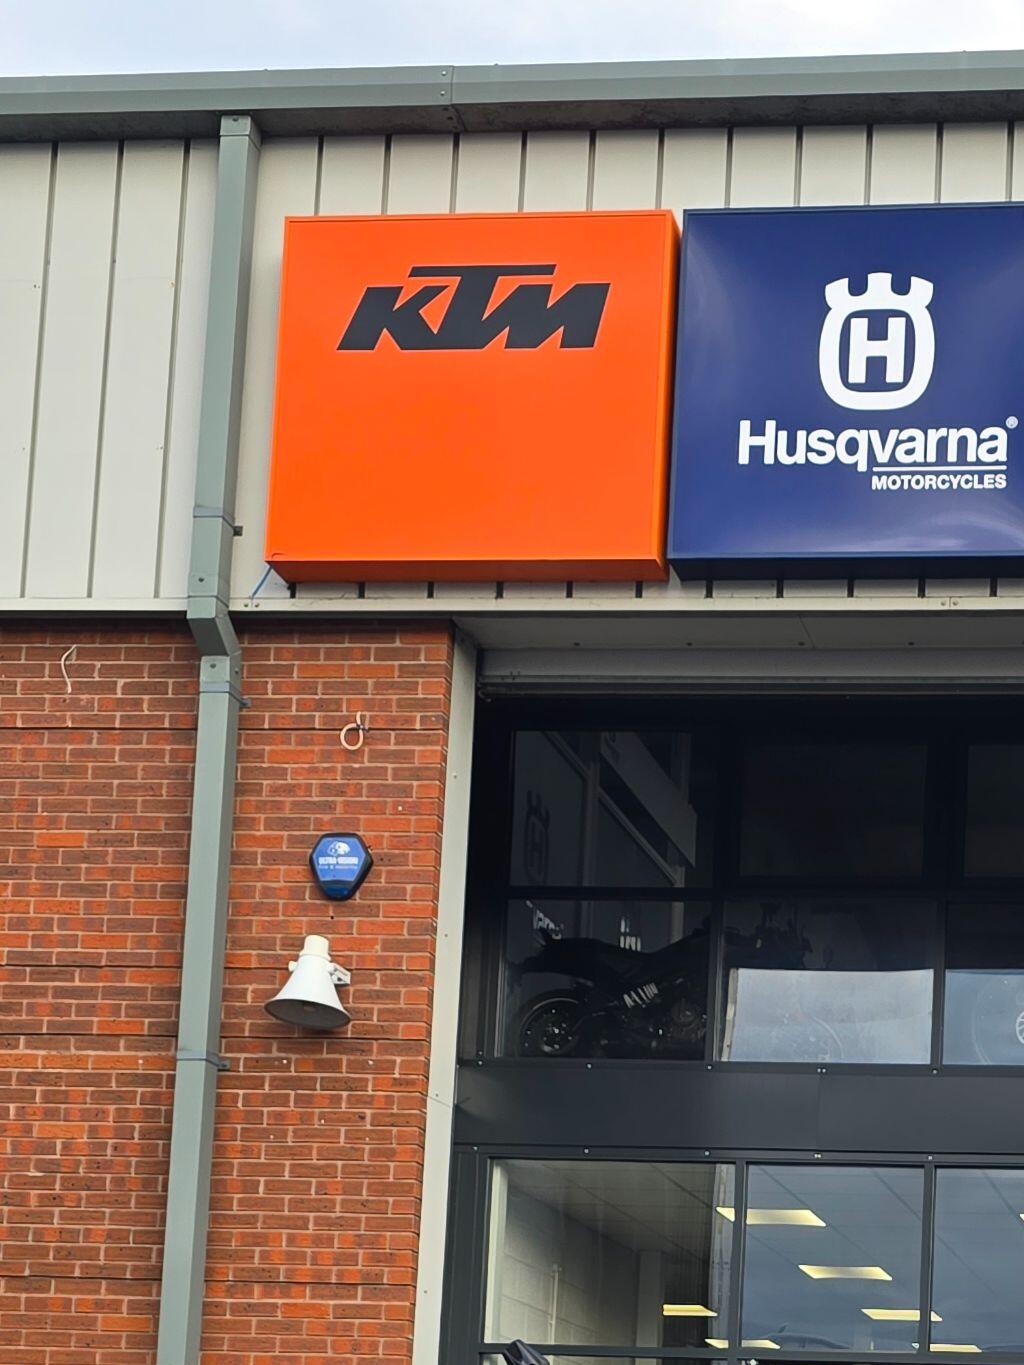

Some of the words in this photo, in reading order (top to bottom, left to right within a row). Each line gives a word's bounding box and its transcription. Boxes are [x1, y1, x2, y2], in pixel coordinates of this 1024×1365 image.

[336, 264, 611, 351] KTM
[738, 419, 1009, 472] Husqvarna
[871, 474, 1007, 490] MOTORCYCLES
